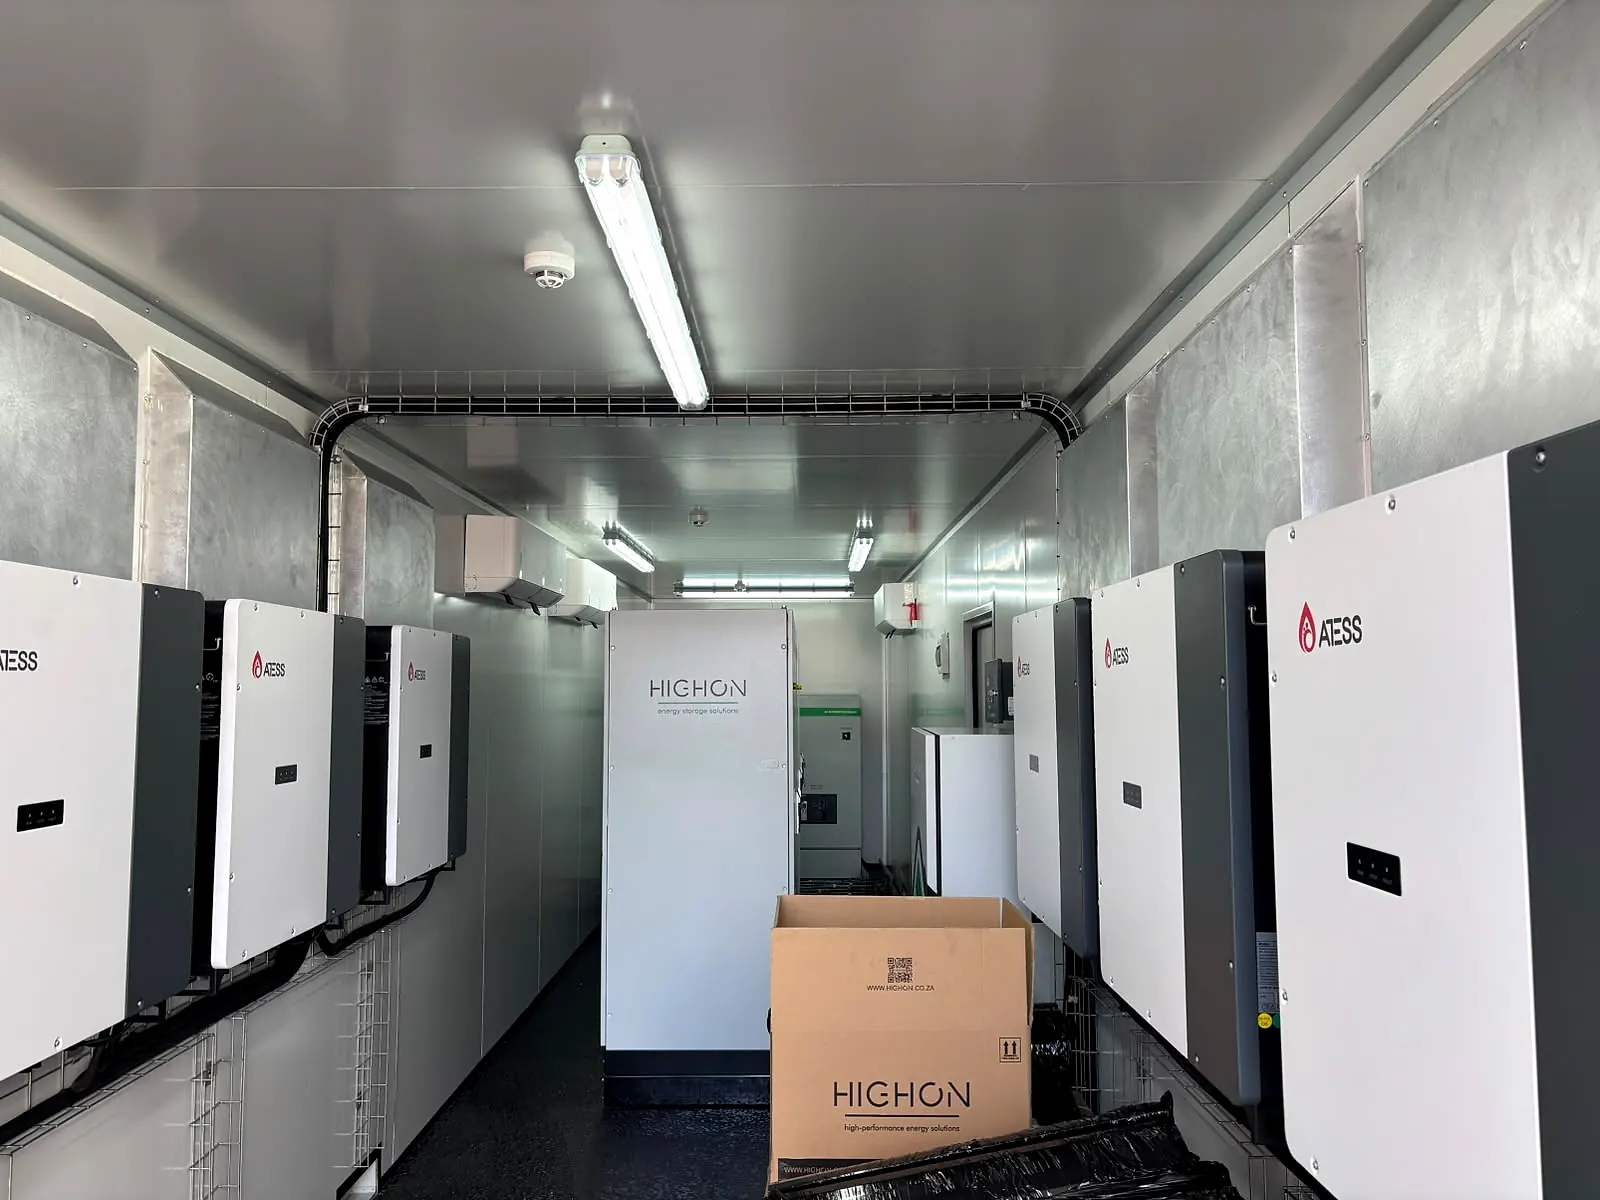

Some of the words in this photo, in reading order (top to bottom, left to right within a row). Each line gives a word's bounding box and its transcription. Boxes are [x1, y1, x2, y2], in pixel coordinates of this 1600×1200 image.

[1318, 614, 1363, 648] ATESS
[0, 649, 38, 671] TESS
[1112, 646, 1129, 666] ATESS
[263, 662, 286, 677] ATESS
[650, 679, 746, 697] HIGHON
[682, 707, 708, 715] storage
[709, 706, 738, 714] solutions
[834, 1081, 970, 1107] HIGHON
[844, 1124, 904, 1132] high-performance
[906, 1125, 929, 1133] energy
[930, 1124, 960, 1132] solutions
